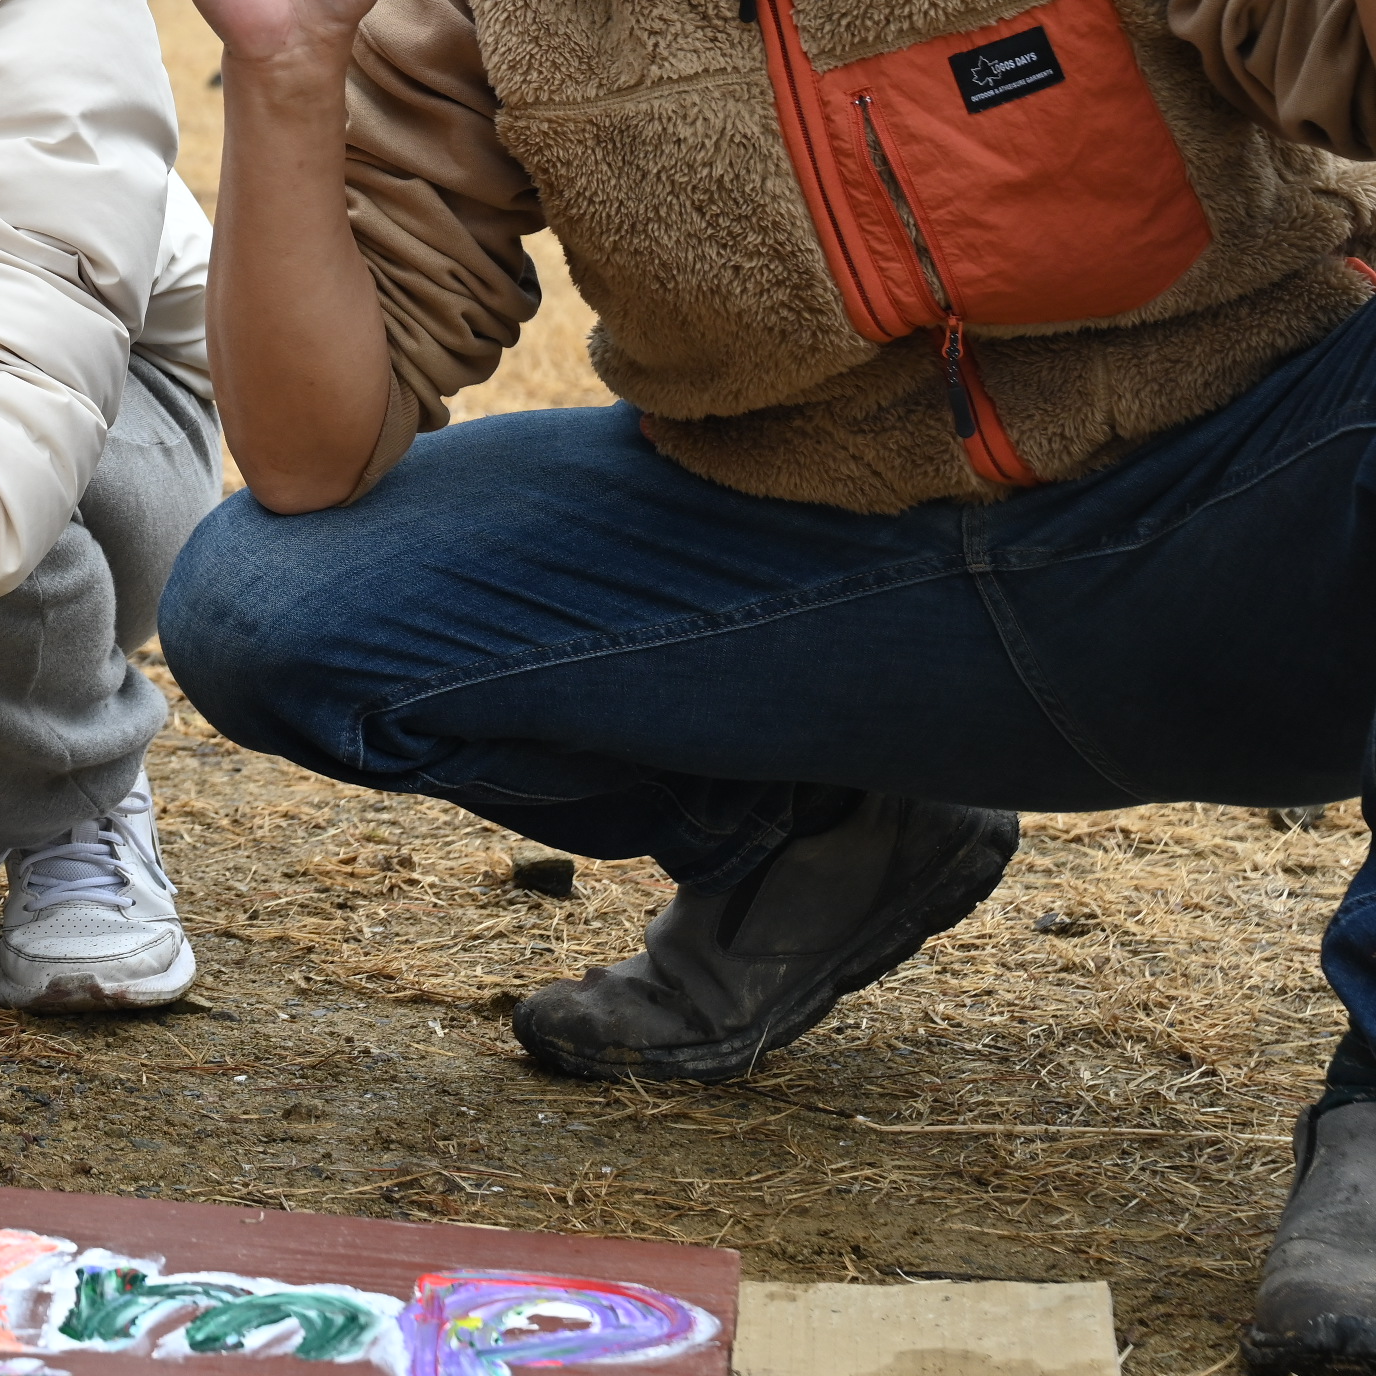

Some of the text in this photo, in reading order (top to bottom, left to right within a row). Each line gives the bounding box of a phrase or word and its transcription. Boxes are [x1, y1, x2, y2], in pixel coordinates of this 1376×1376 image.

[991, 52, 1038, 74] LOGOS DAYS
[971, 89, 995, 103] OUTDOOR
[1026, 68, 1054, 84] GARMENTS
